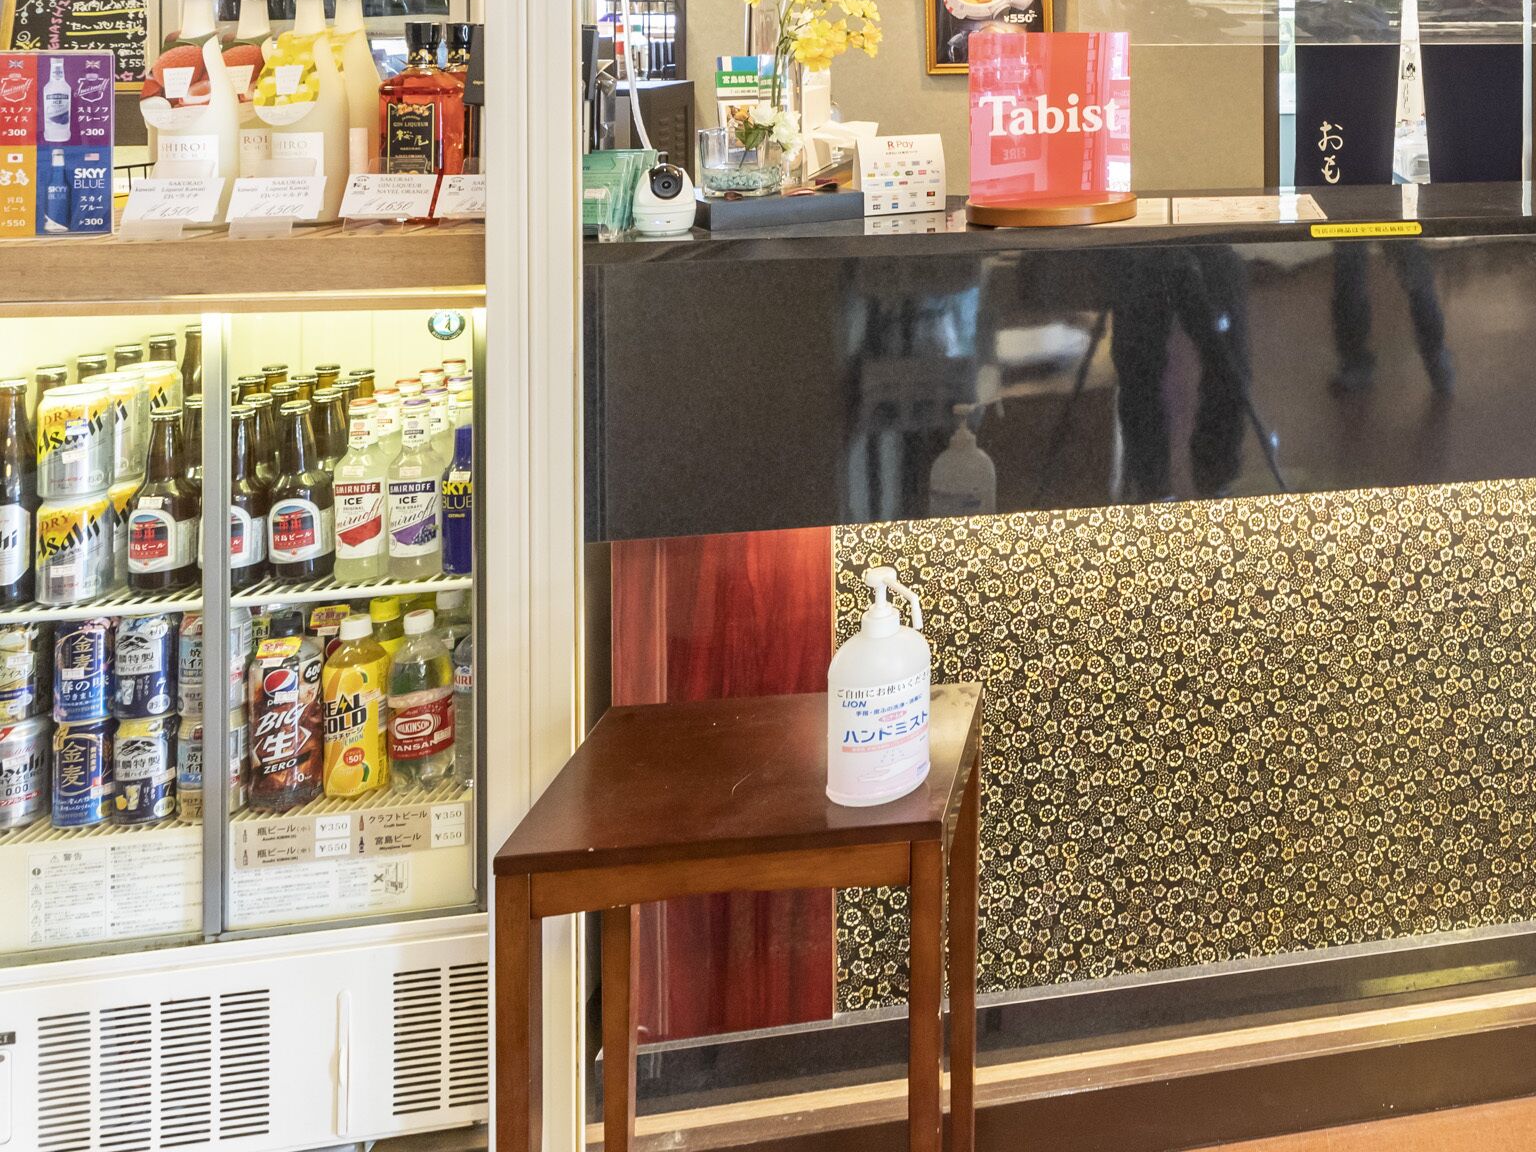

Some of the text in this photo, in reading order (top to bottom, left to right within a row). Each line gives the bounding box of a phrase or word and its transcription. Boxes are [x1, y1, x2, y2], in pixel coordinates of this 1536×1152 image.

[1003, 13, 1033, 24] ¥550
[0, 106, 32, 114] スミノフ
[77, 106, 110, 114] スミノフ
[978, 93, 1122, 137] Tabist
[4, 115, 28, 123] アイス
[896, 140, 914, 150] Pay
[73, 167, 107, 179] SKYY
[73, 179, 105, 189] BLUE
[43, 407, 74, 425] DRY
[335, 483, 378, 494] SMIRNOFF
[389, 483, 432, 494] SMIRNOFF
[344, 496, 363, 505] ICE
[399, 496, 418, 505] ICE
[41, 514, 70, 530] DRY
[37, 514, 100, 560] Asahi
[273, 531, 313, 542] 宮島ビール
[72, 635, 95, 670] 金麦
[842, 700, 867, 708] LION
[255, 703, 307, 737] BIG
[843, 709, 928, 744] ハンドミスト
[262, 731, 296, 763] 生
[61, 741, 85, 788] 金麦
[263, 757, 297, 775] ZERO
[369, 810, 428, 824] クラフトビール
[435, 810, 463, 821] ¥350
[319, 822, 348, 832] ¥350
[374, 833, 422, 845] 宮島ビール
[435, 831, 463, 841] ¥550
[319, 842, 348, 853] ¥550
